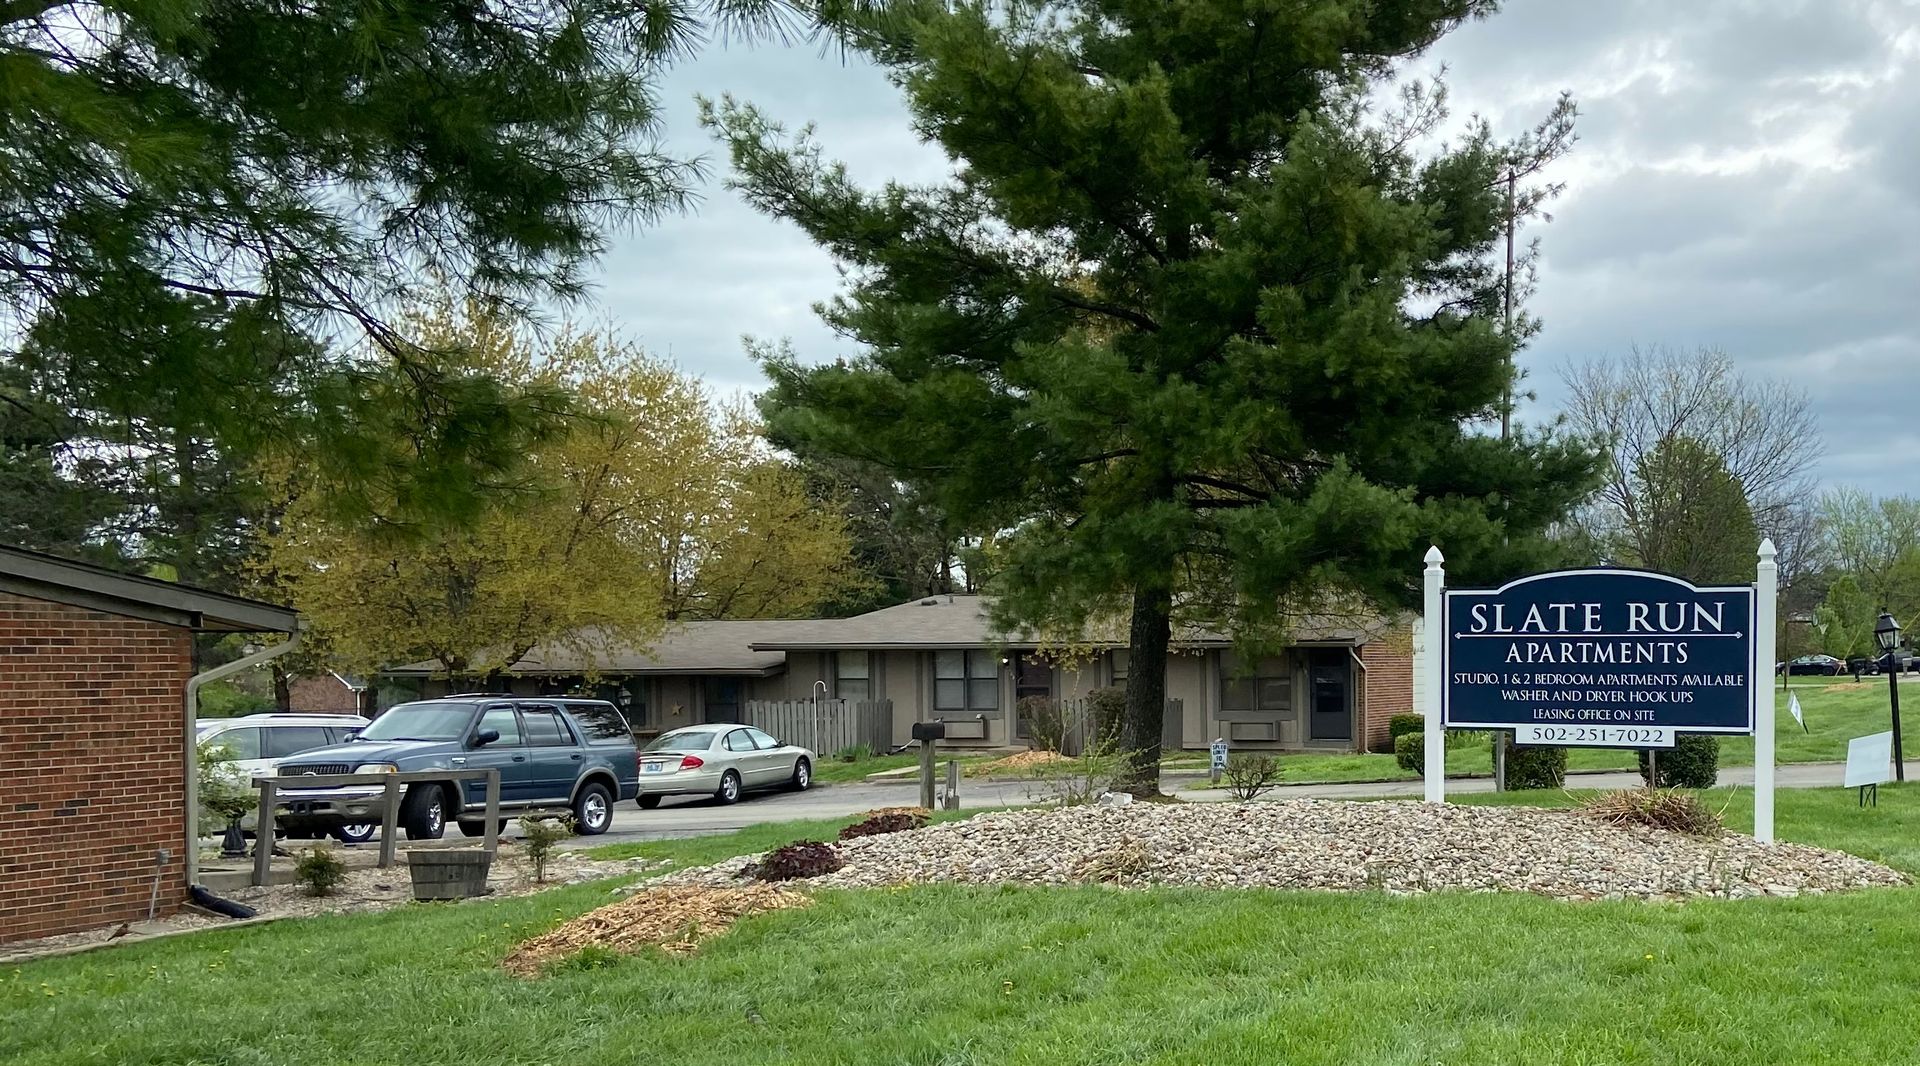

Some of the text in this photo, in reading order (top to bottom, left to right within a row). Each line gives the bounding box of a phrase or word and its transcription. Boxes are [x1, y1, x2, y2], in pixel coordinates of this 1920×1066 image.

[1470, 601, 1726, 633] SLATE RUN
[1504, 642, 1688, 664] APARTMENTS
[1503, 673, 1508, 685] 1
[1511, 673, 1522, 685] &
[1523, 673, 1531, 685] 2
[1534, 673, 1594, 686] BEDROOM
[1597, 673, 1678, 687] APARTMENTS
[1680, 674, 1744, 687] AVAILABLE
[1501, 689, 1694, 703] WASHER AND DRYER HOOK UPS
[1533, 708, 1656, 721] LEASING OFFICE ON SITE
[1532, 727, 1663, 743] 502-251-7022
